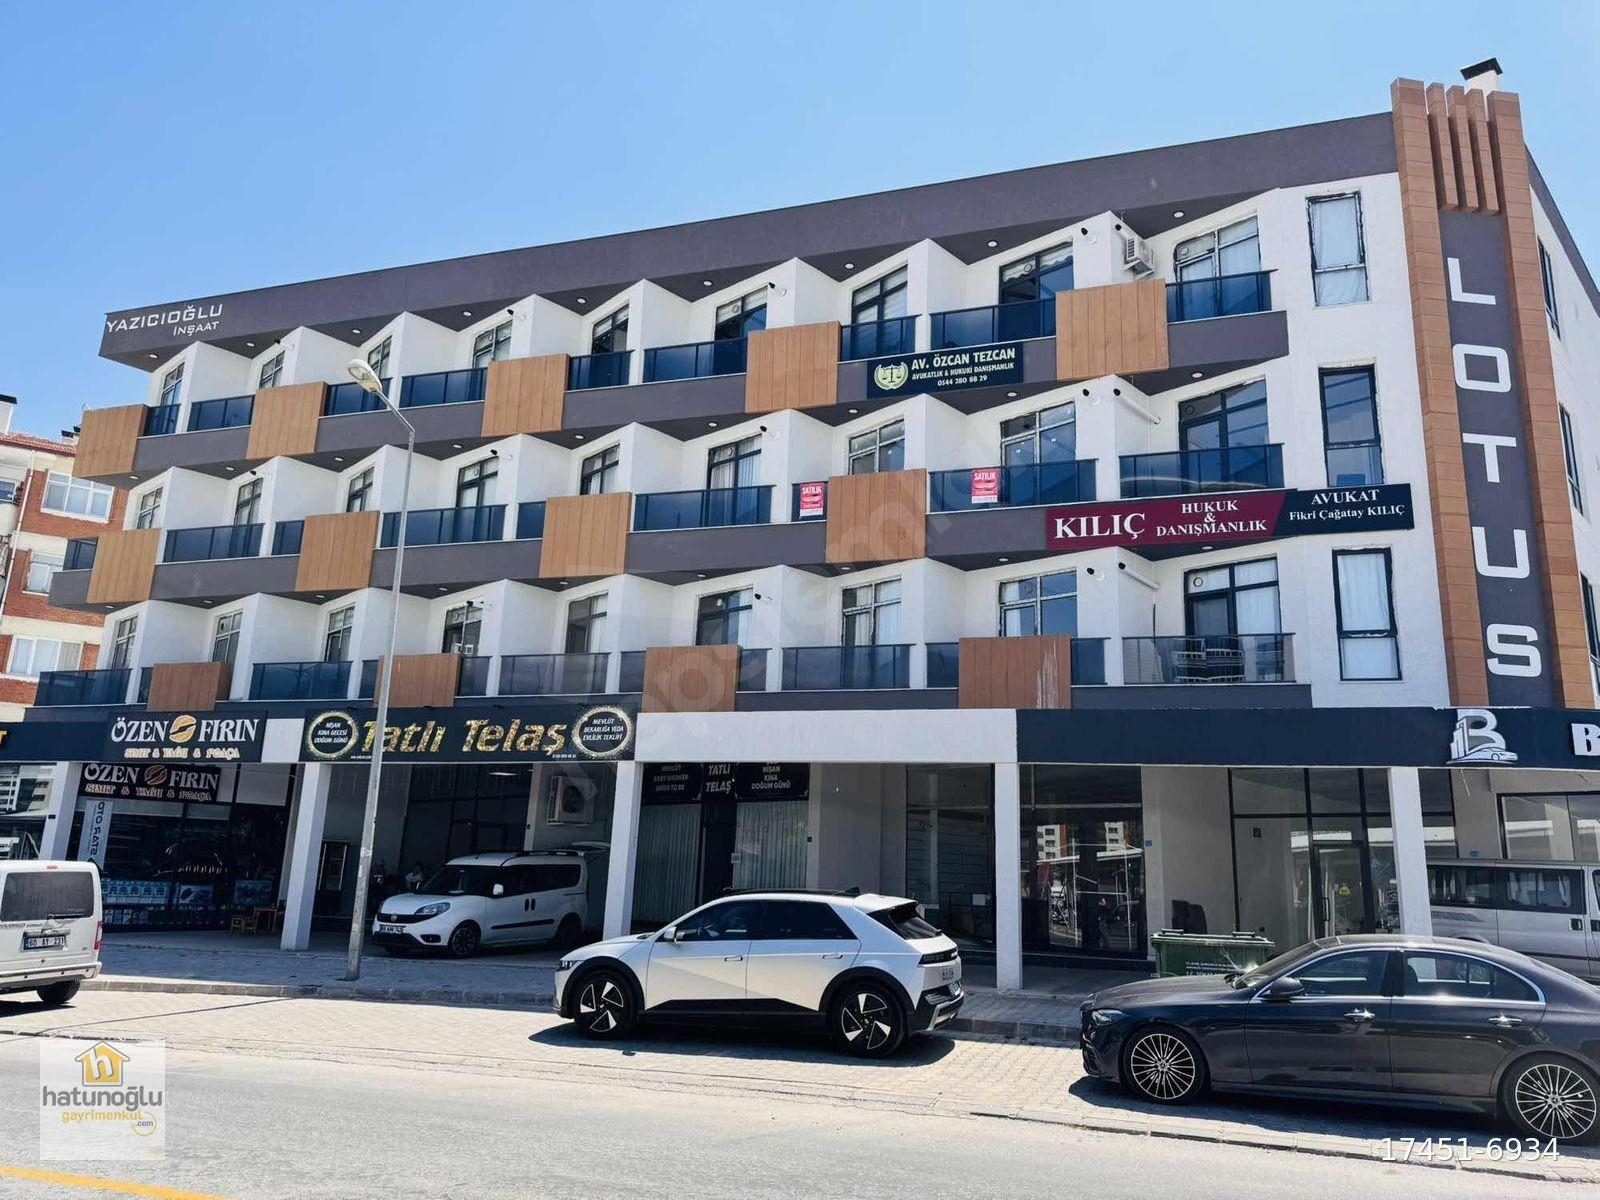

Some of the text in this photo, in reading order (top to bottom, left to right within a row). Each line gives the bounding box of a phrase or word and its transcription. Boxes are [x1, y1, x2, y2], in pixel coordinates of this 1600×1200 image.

[107, 304, 223, 333] YAZICIOĞLU
[911, 348, 1016, 371] AV. ÖZCAN TEZCAN
[911, 371, 943, 381] AVUKATLIK
[937, 379, 954, 387] 0544
[1447, 257, 1542, 677] LOTUS
[973, 472, 998, 481] SATILIK
[1311, 489, 1380, 505] AVUKAT
[1181, 500, 1239, 514] HUKUK
[1289, 504, 1406, 522] Fikri Çağatay KILIÇ
[1203, 512, 1216, 522] &
[1054, 513, 1146, 541] KILIÇ
[1156, 520, 1268, 537] DANIŞMANLIK
[111, 717, 260, 743] ÖZEN FIRIN
[462, 718, 567, 756] Telaş
[708, 764, 731, 776] TATLI
[169, 770, 219, 791] FIRIN
[706, 780, 732, 794] TELAŞ
